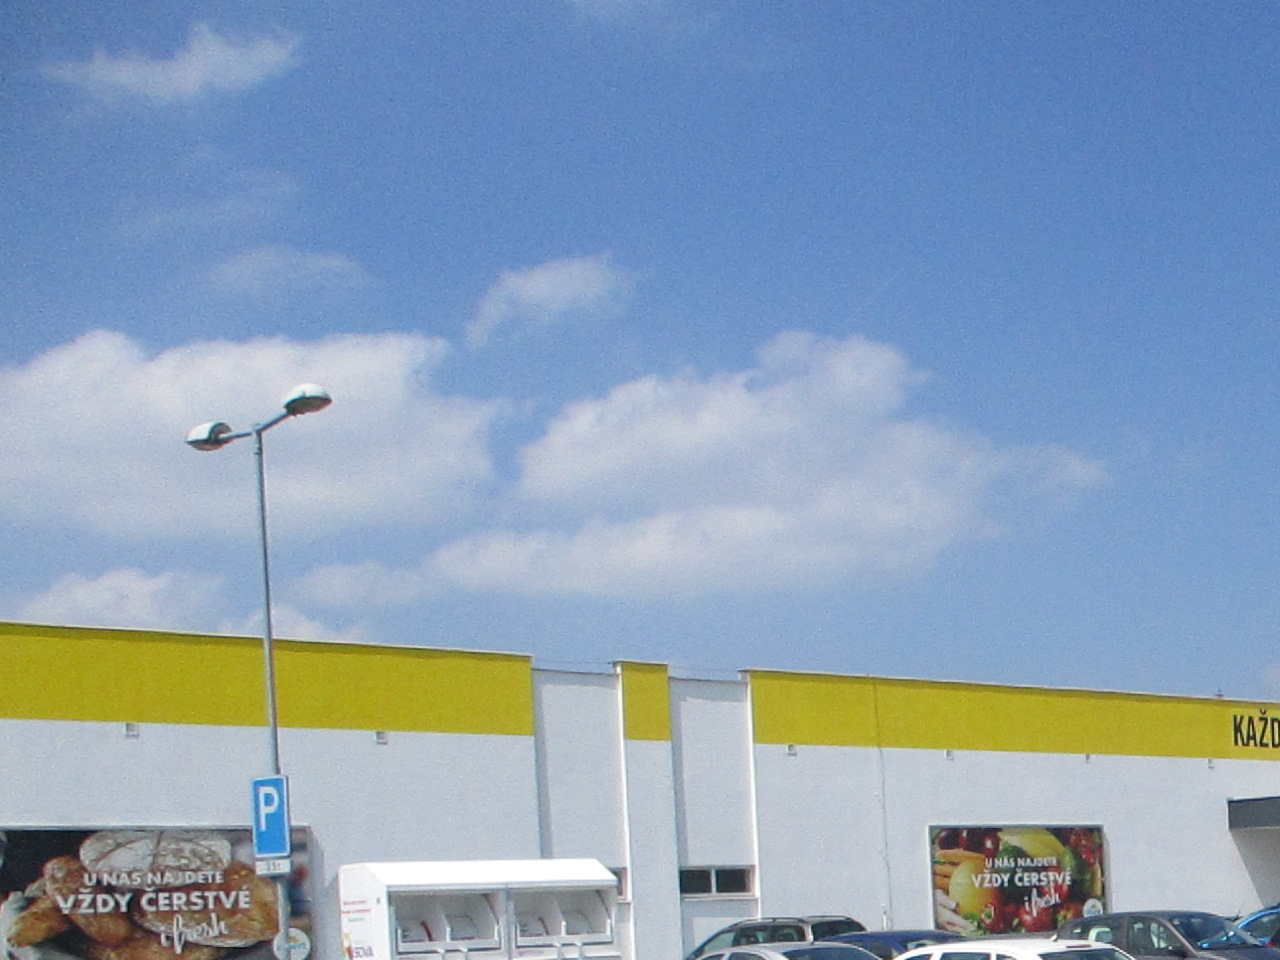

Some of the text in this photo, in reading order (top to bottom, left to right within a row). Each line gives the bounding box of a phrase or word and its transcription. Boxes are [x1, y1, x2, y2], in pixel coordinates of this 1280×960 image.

[259, 786, 279, 832] P
[985, 857, 993, 868] U
[994, 855, 1015, 868] NÁS
[84, 873, 97, 886] U
[147, 870, 225, 886] NAJDETE
[971, 867, 1072, 888] VŽDY ČERSTVÉ
[55, 886, 251, 915] VŽDY ČERSTVÉ
[173, 912, 228, 954] fresh
